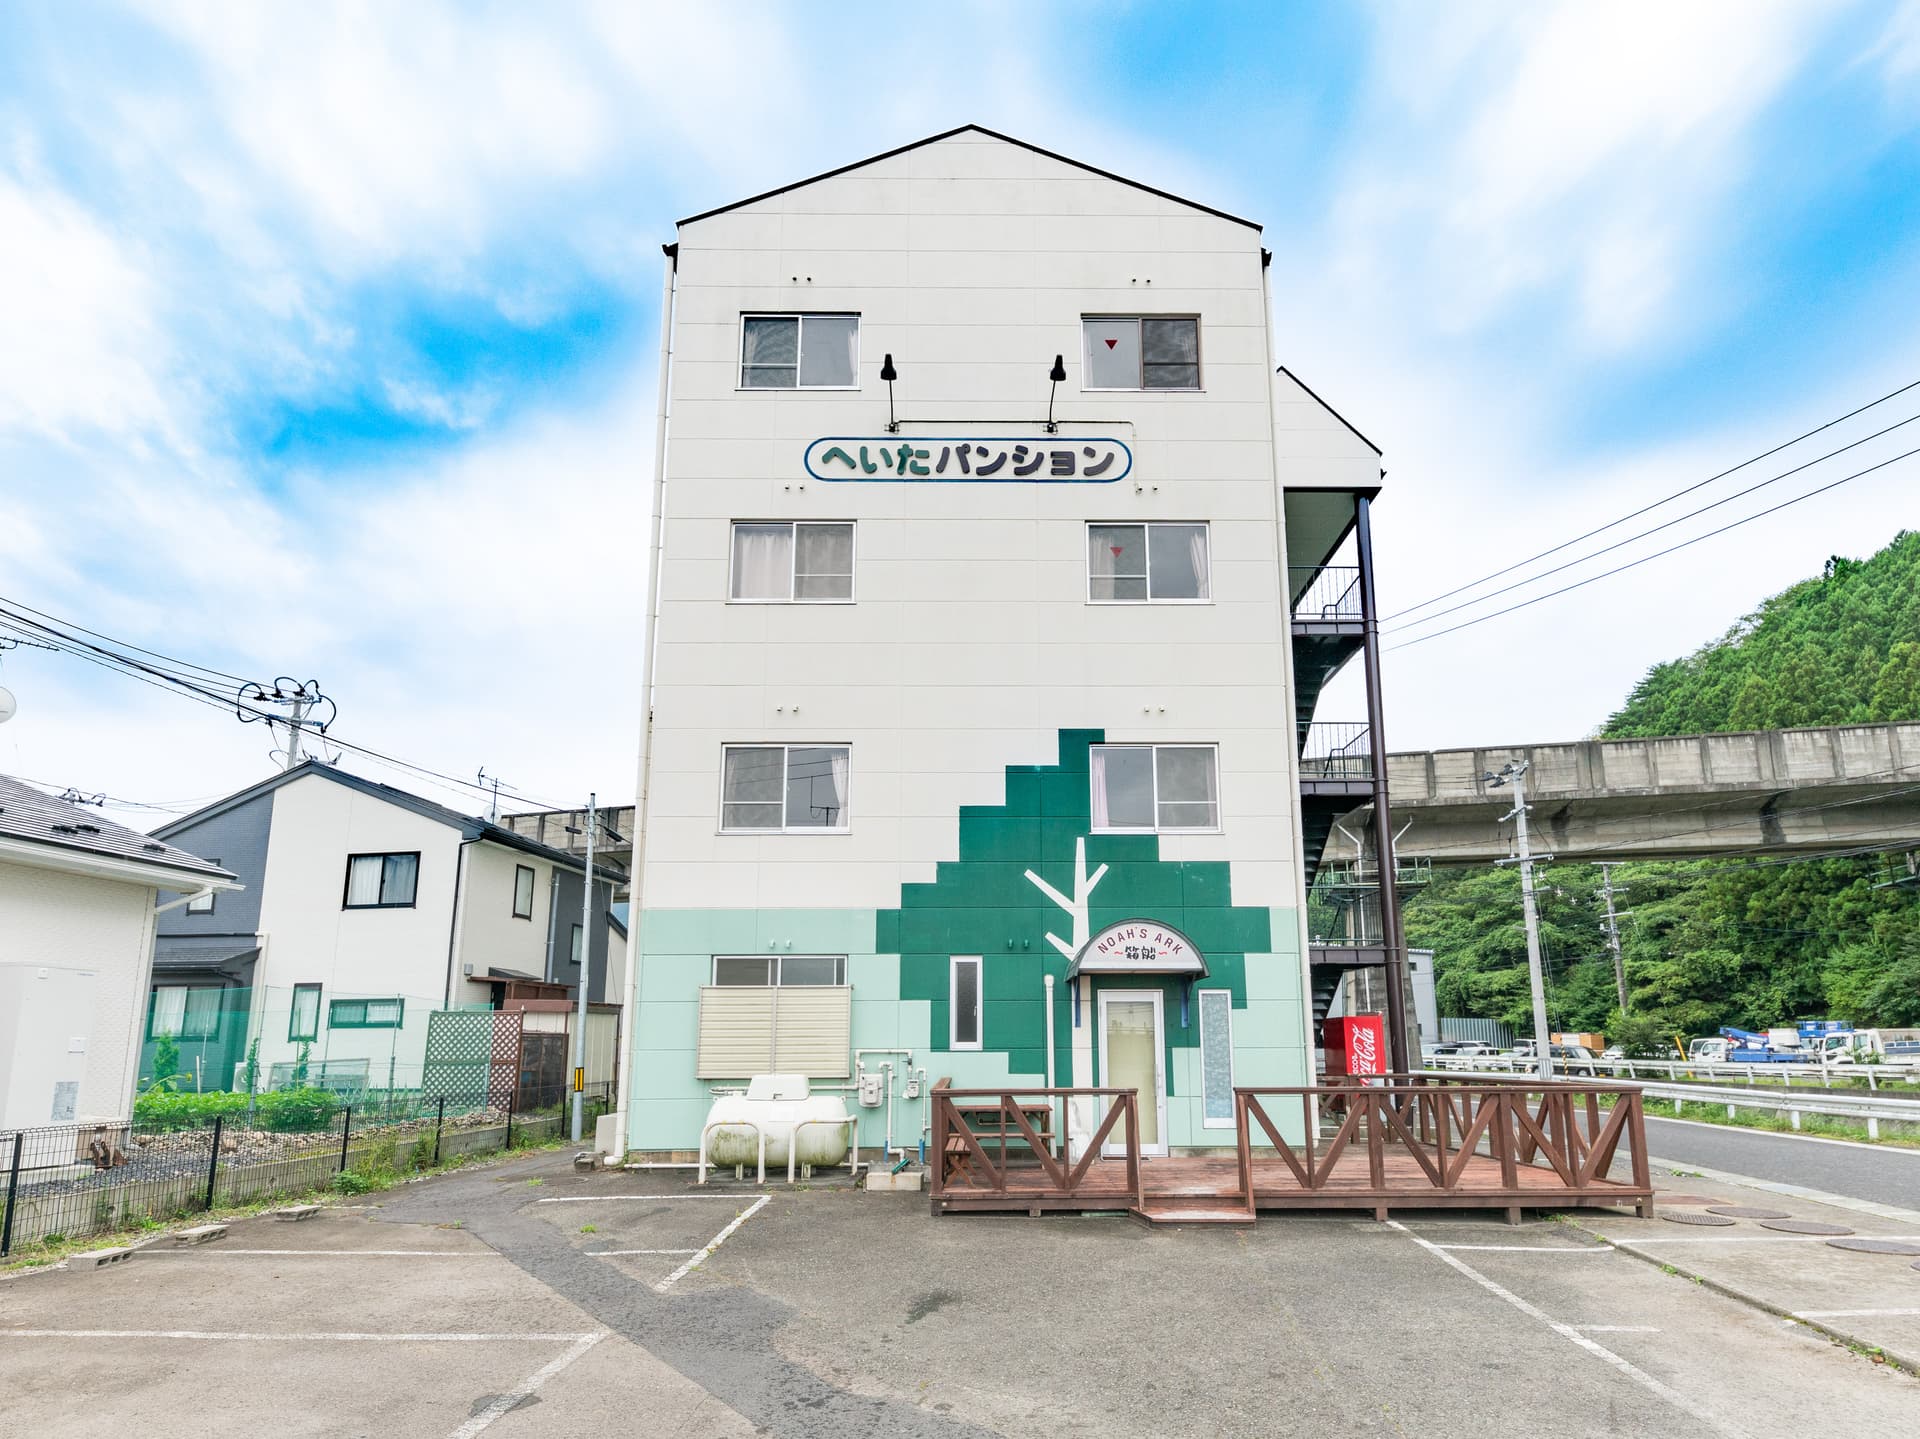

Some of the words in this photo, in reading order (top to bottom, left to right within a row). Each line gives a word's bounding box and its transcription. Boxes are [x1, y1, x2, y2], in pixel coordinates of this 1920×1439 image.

[1098, 927, 1148, 954] NOAH'S
[1154, 932, 1184, 955] ARK
[1352, 1024, 1376, 1087] ca-Cola
